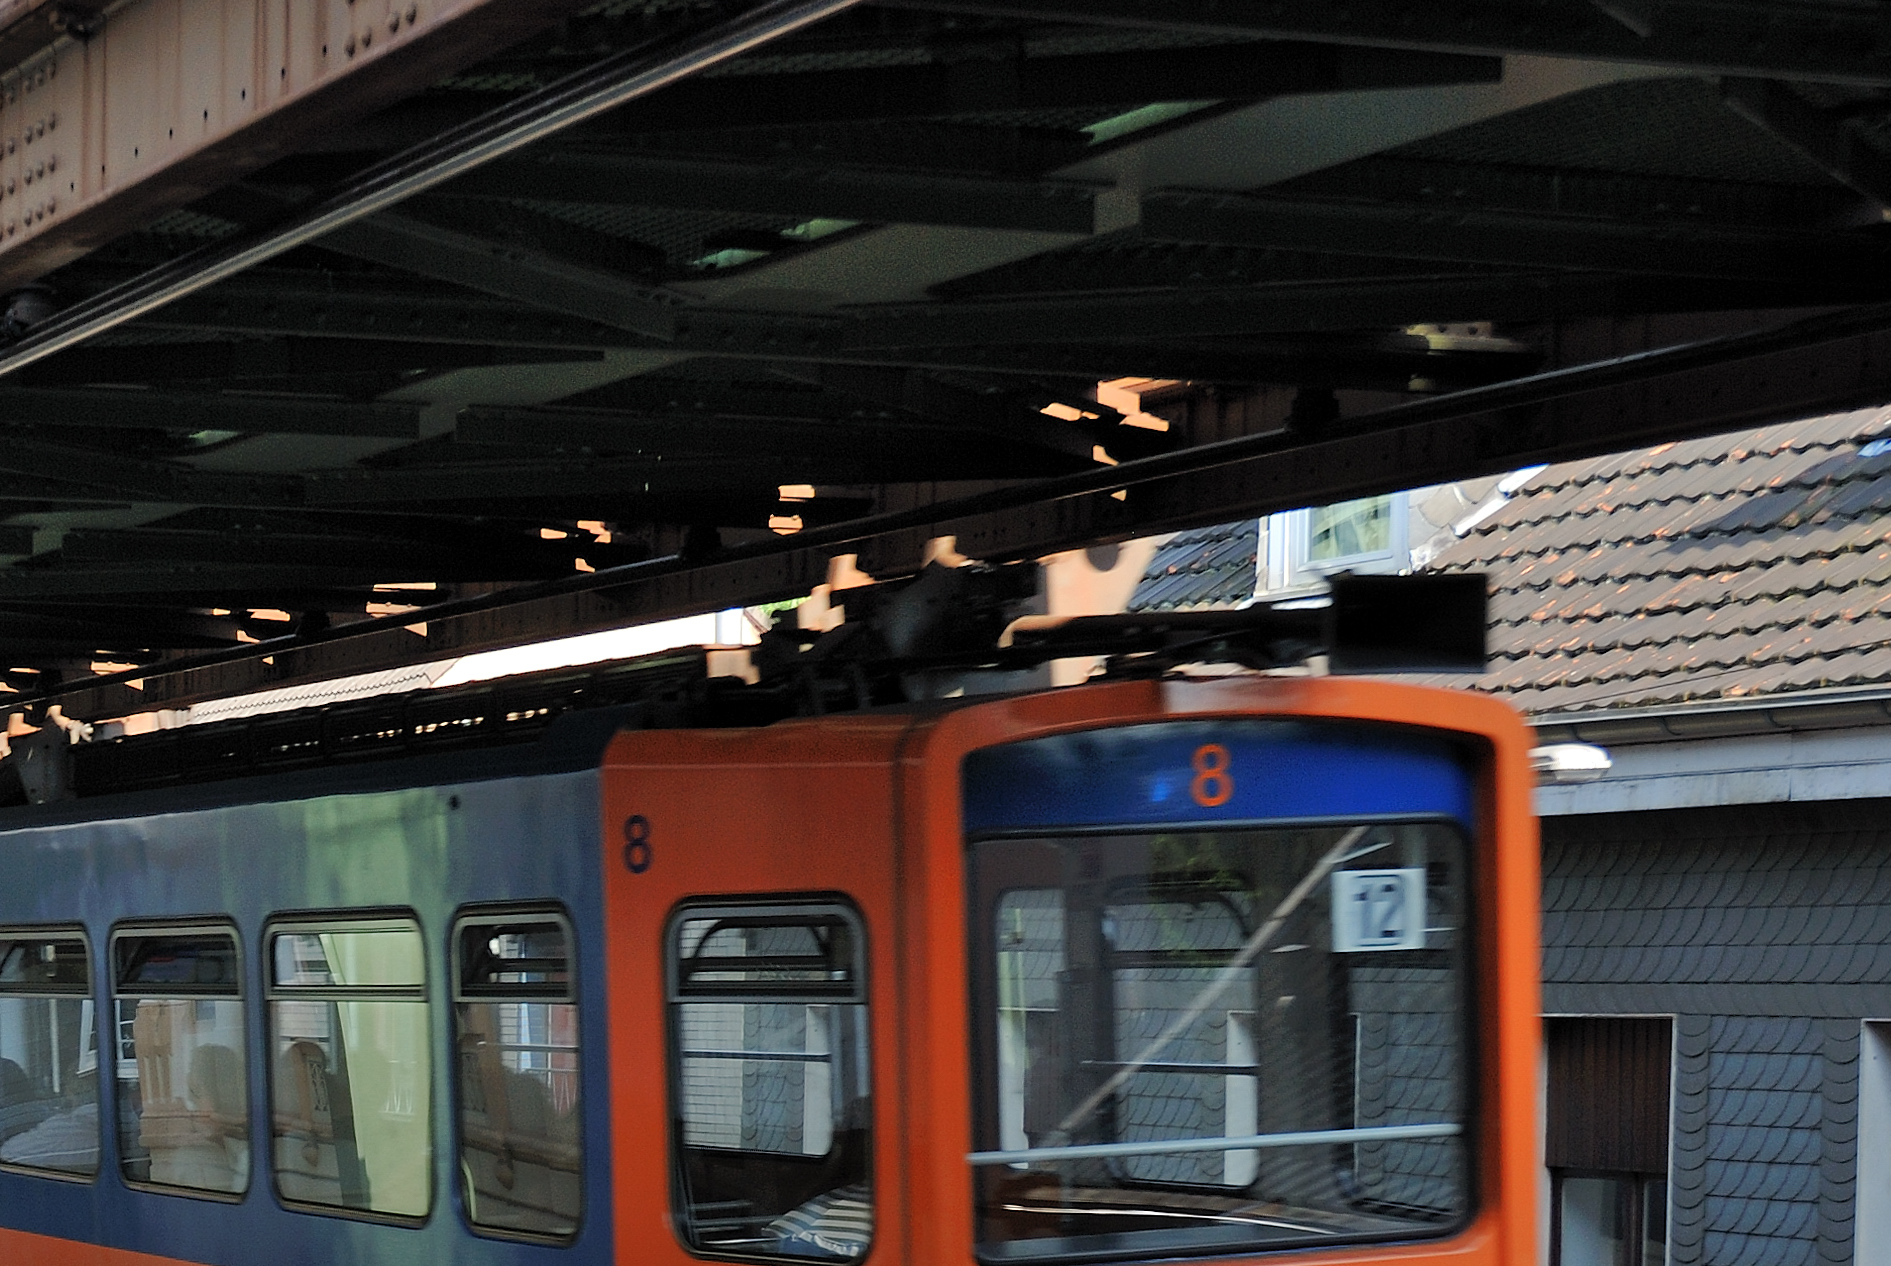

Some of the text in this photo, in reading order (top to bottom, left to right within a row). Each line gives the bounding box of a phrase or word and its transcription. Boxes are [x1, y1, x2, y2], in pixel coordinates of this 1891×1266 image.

[1189, 743, 1234, 807] 8
[622, 813, 654, 875] 8
[1352, 882, 1406, 940] 12
